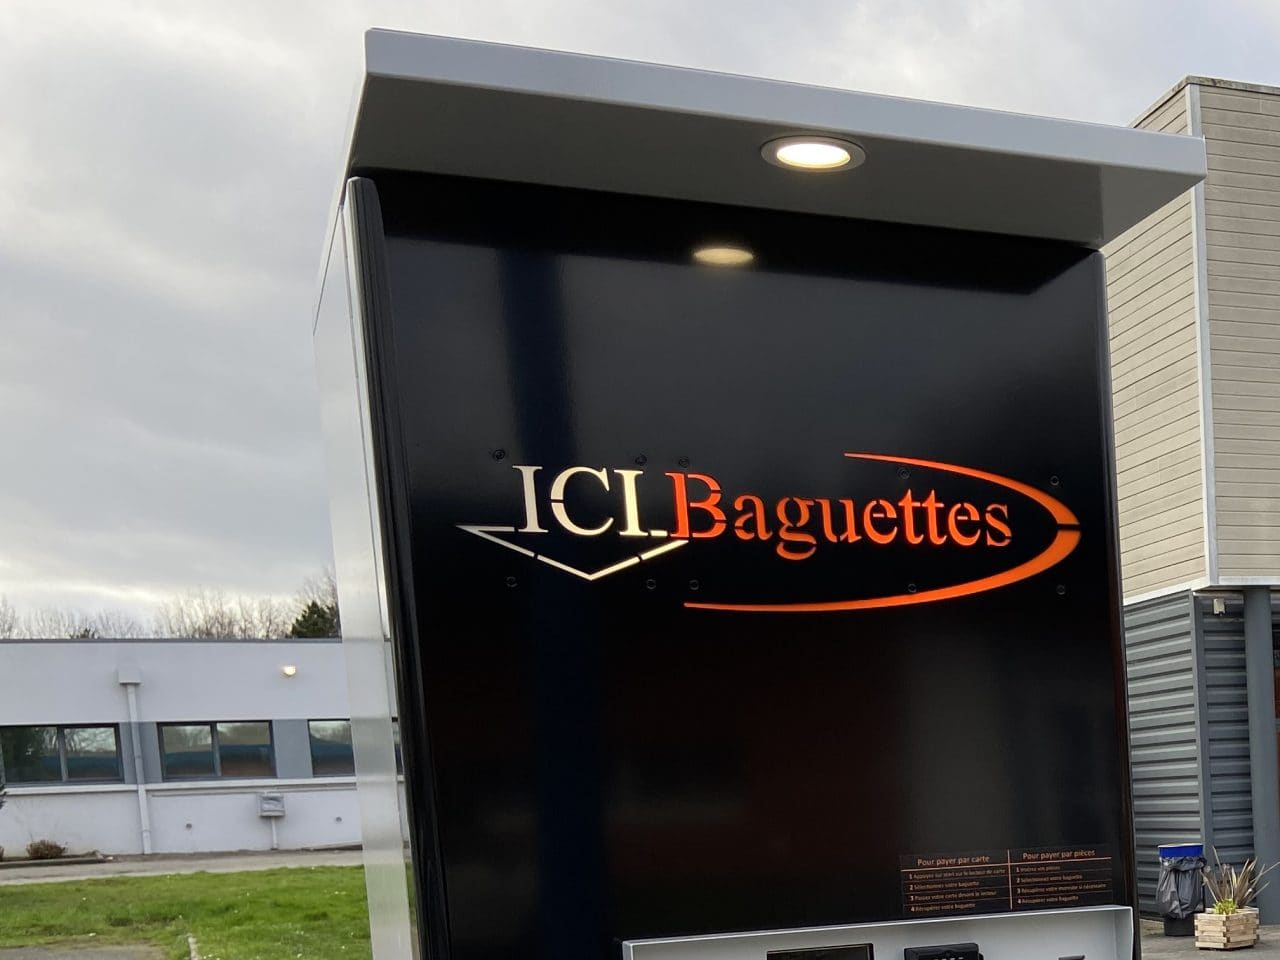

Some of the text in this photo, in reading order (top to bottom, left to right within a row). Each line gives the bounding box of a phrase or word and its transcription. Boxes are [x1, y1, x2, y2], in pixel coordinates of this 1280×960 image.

[512, 465, 1012, 561] ICI Baguettes
[1022, 852, 1039, 860] Pour
[1074, 849, 1095, 857] pièces
[917, 858, 934, 866] Pour
[936, 857, 956, 866] payer
[958, 857, 970, 865] par
